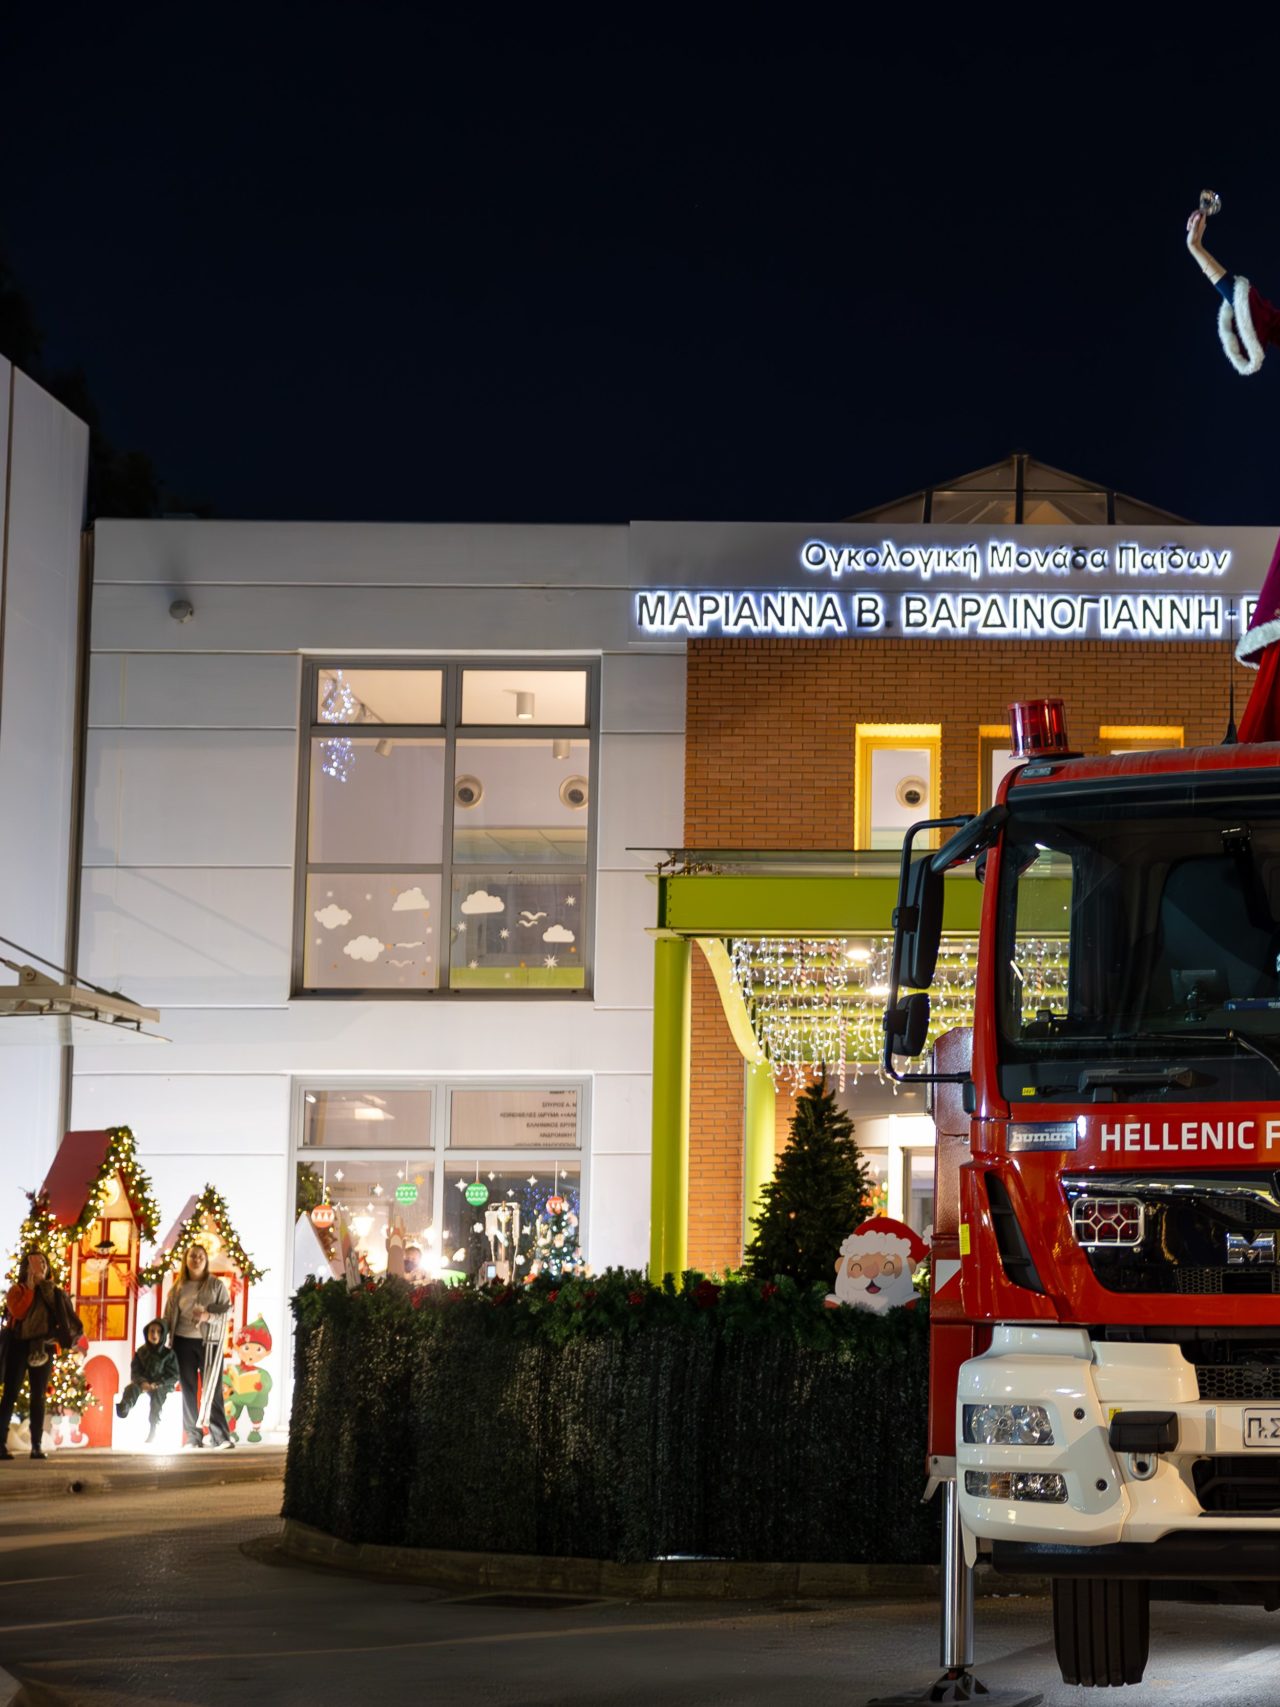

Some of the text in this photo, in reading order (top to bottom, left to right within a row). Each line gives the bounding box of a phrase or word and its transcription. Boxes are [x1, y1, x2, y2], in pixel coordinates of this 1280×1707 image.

[804, 542, 1228, 573] Ογκολογική Μονάδα Παίδων
[637, 594, 843, 628] ΜΑΡΙΑΝΝΑ
[856, 597, 893, 628] Β.
[1101, 1121, 1254, 1152] HELLENIC
